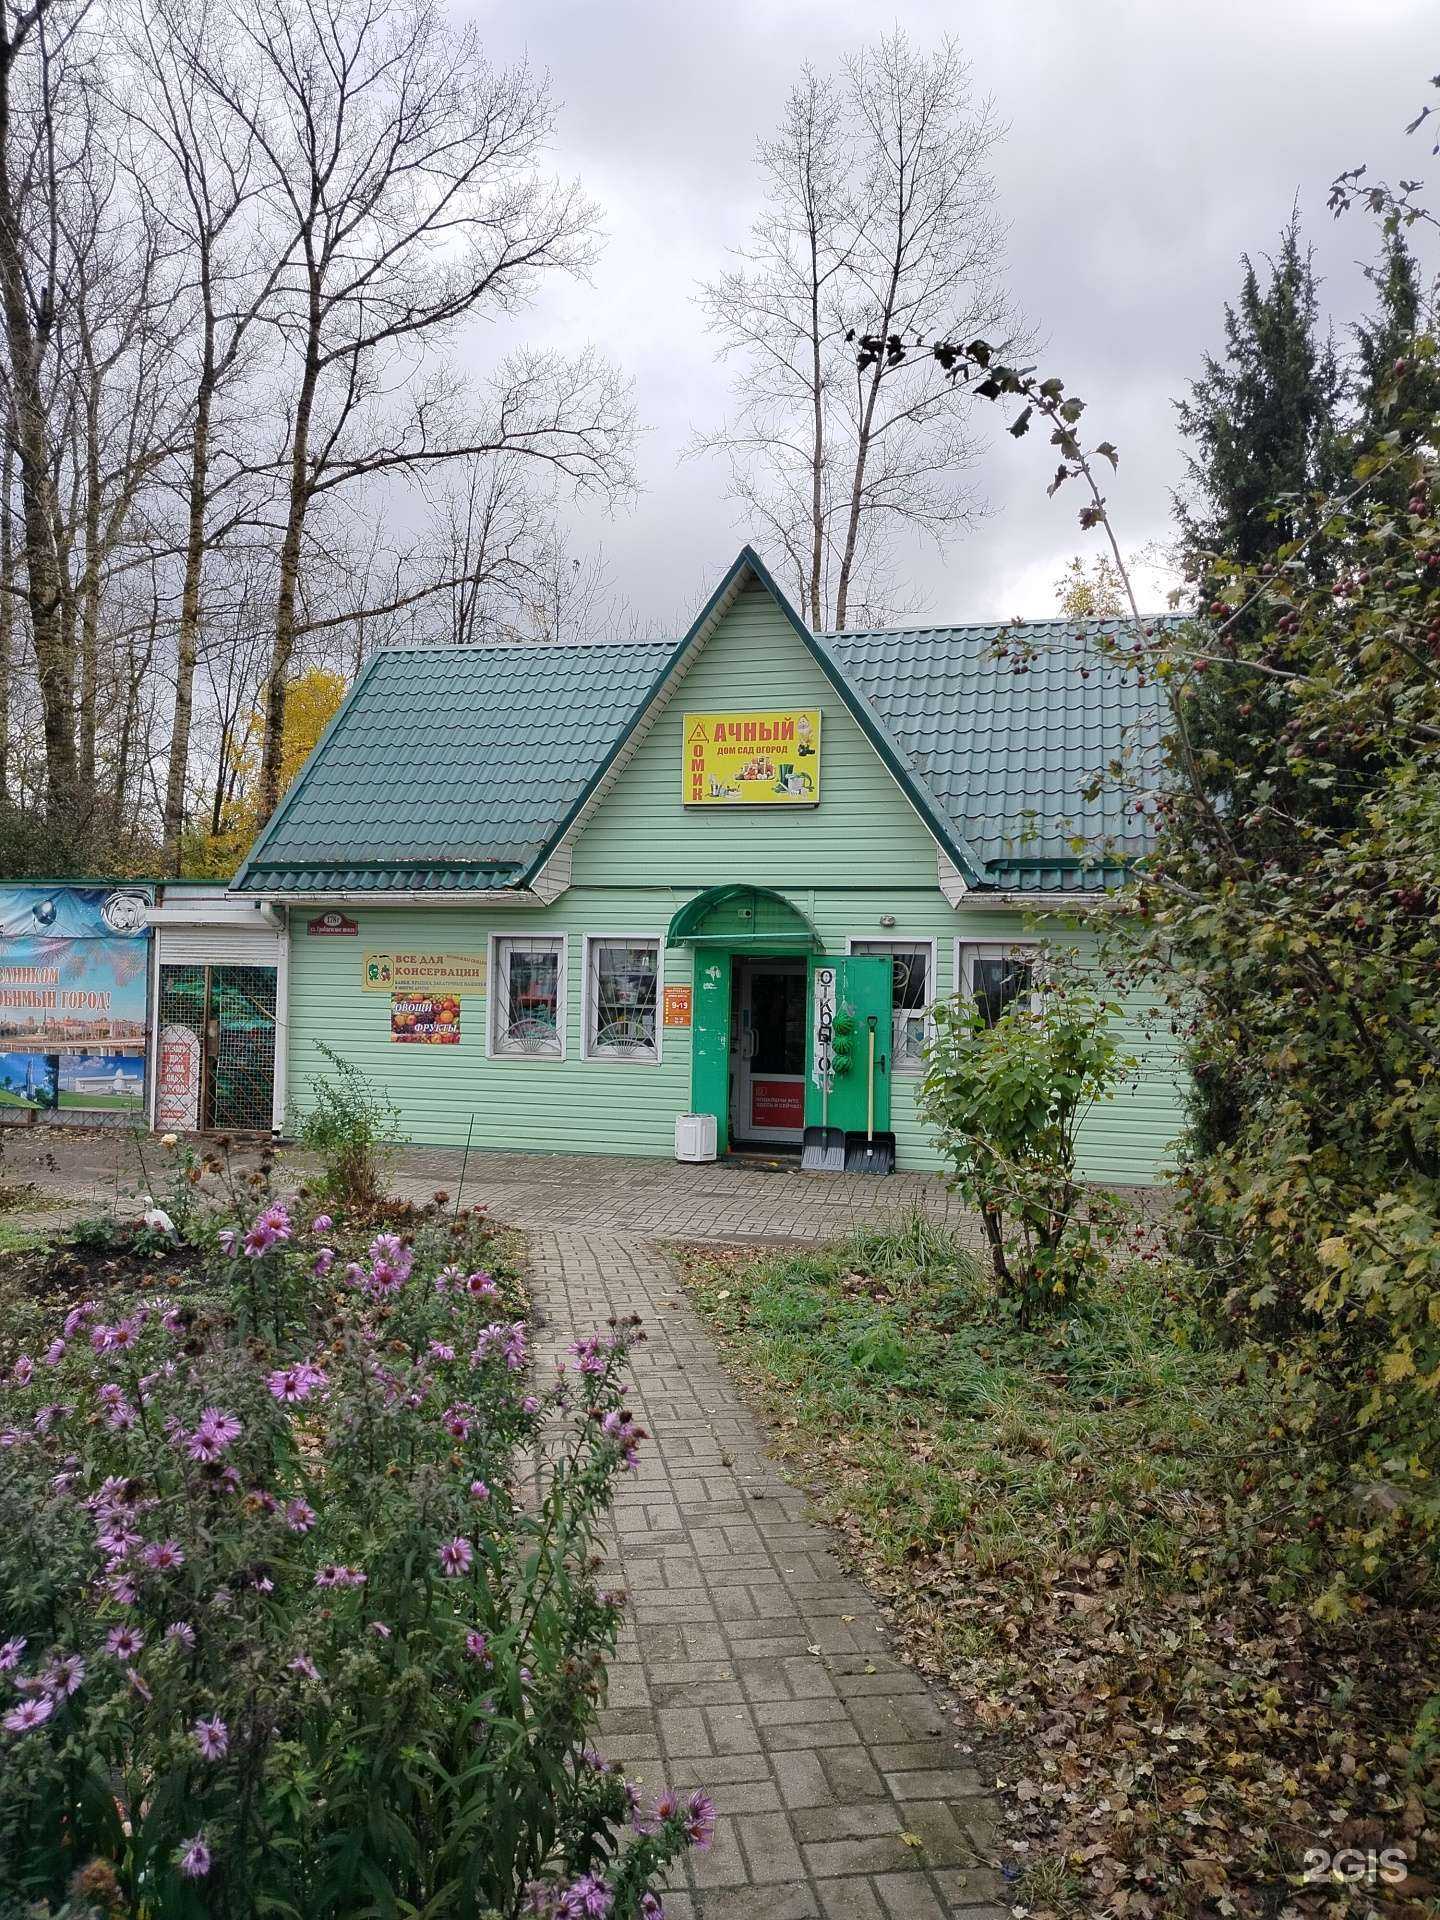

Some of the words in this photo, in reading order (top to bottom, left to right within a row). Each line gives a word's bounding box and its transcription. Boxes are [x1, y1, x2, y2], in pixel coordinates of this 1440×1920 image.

[717, 746, 736, 755] ДОМ
[737, 746, 754, 755] САД
[756, 745, 788, 754] ОГОРОД
[395, 955, 417, 964] ВСЕ
[419, 956, 444, 965] ДЛЯ
[394, 967, 480, 978] КОНСЕРВАЦИИ
[61, 991, 111, 1011] ГОРОД!
[395, 1003, 432, 1013] ОВОЩИ
